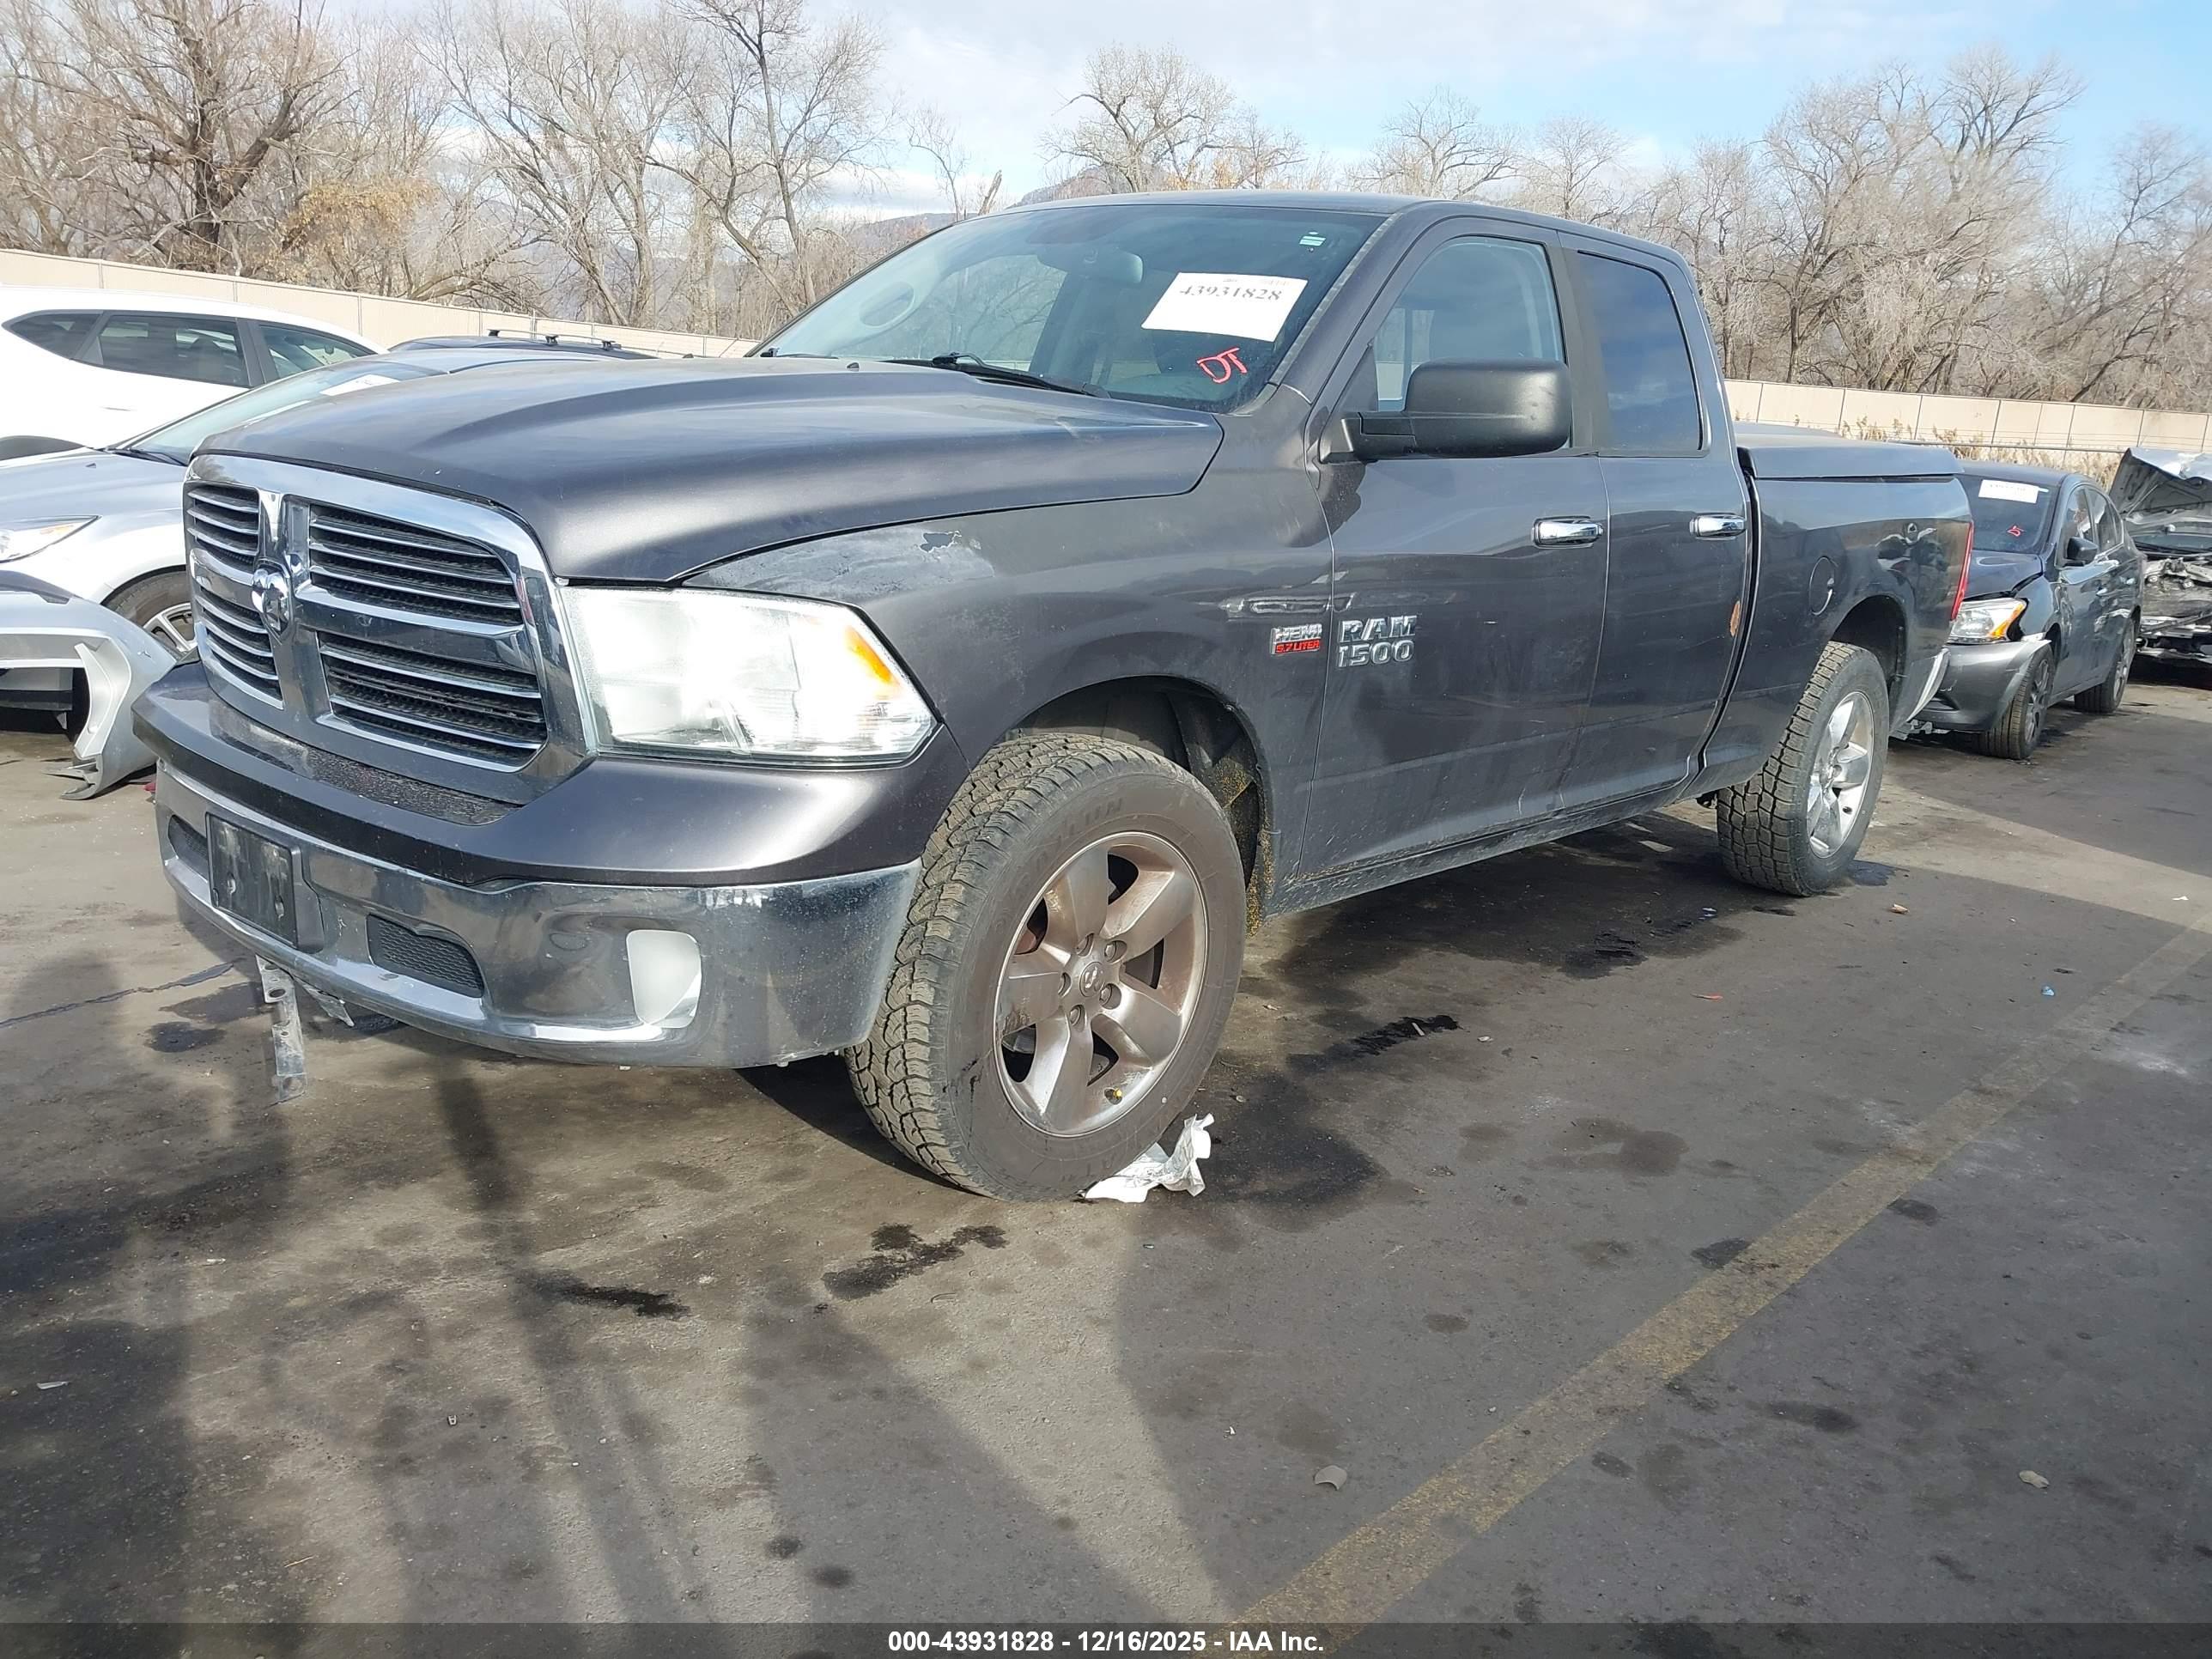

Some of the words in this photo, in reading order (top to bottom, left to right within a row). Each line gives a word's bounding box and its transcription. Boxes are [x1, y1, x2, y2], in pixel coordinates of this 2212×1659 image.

[1179, 284, 1283, 301] 43931828
[1273, 623, 1322, 642] HEMI
[1339, 615, 1417, 643] RAM
[1275, 642, 1292, 653] 5.7
[1293, 640, 1320, 652] LITER
[1338, 640, 1416, 667] 1500
